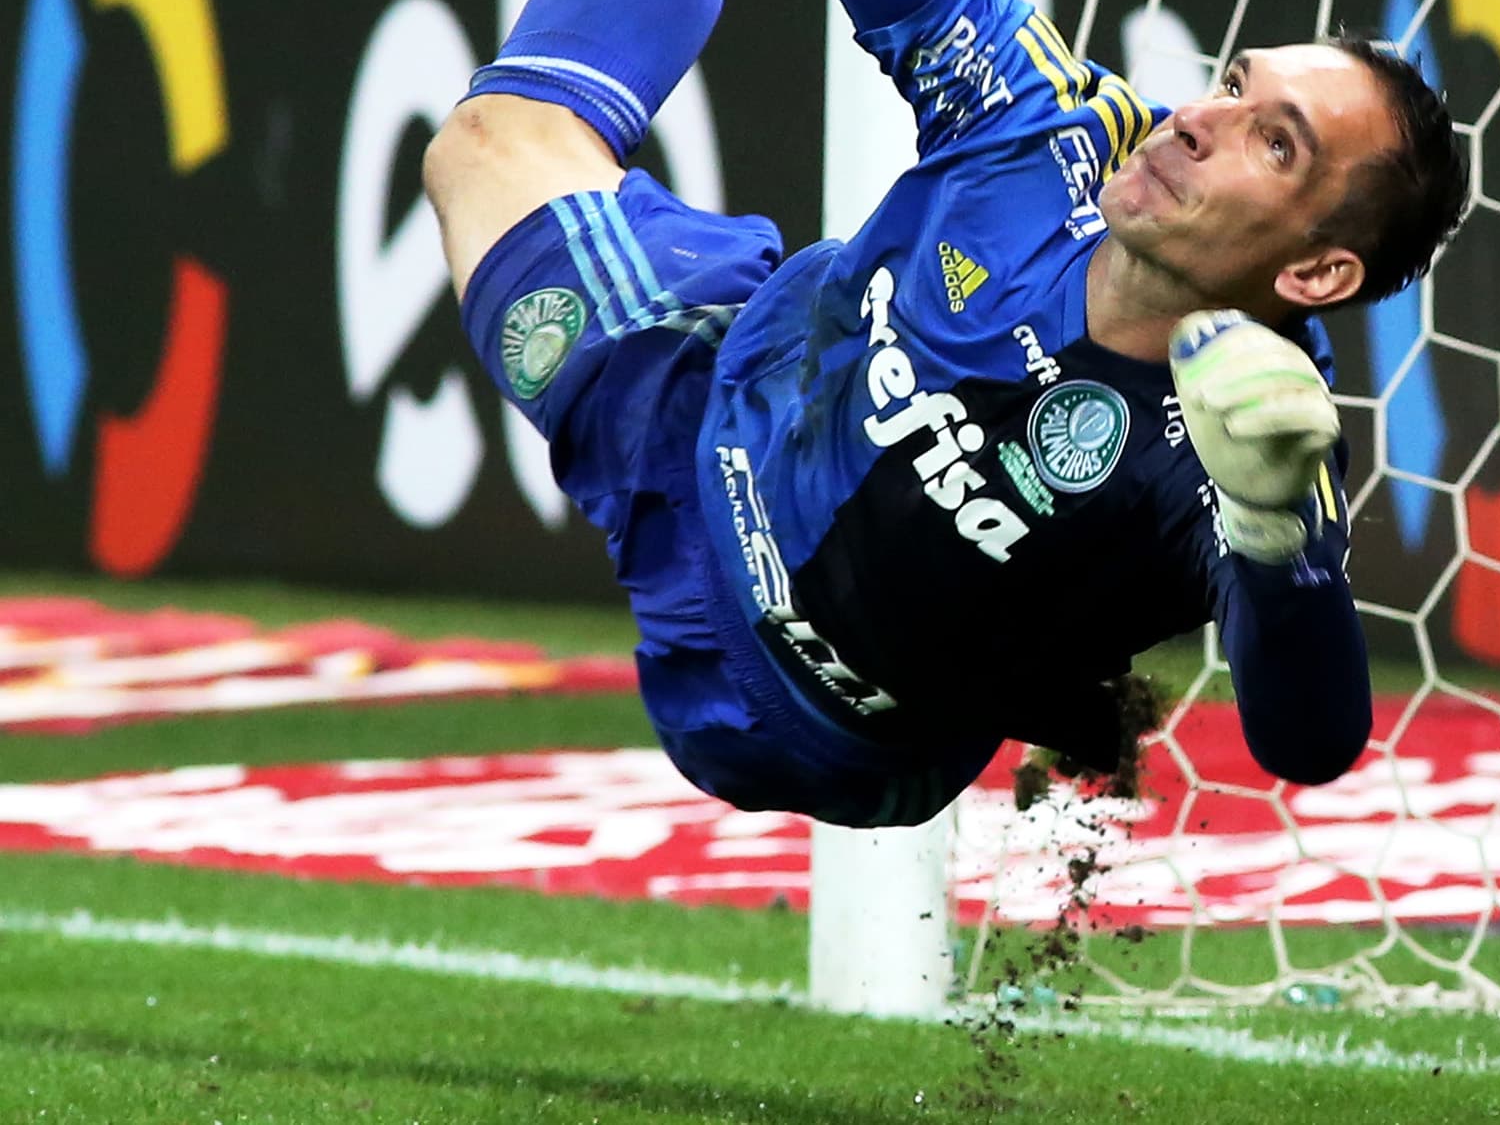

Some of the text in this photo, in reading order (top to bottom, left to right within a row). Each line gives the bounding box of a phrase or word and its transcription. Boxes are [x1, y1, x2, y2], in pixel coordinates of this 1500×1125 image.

[937, 242, 965, 314] adidas
[859, 266, 1031, 564] crefisa
[1038, 400, 1105, 481] PALMEIRAS
